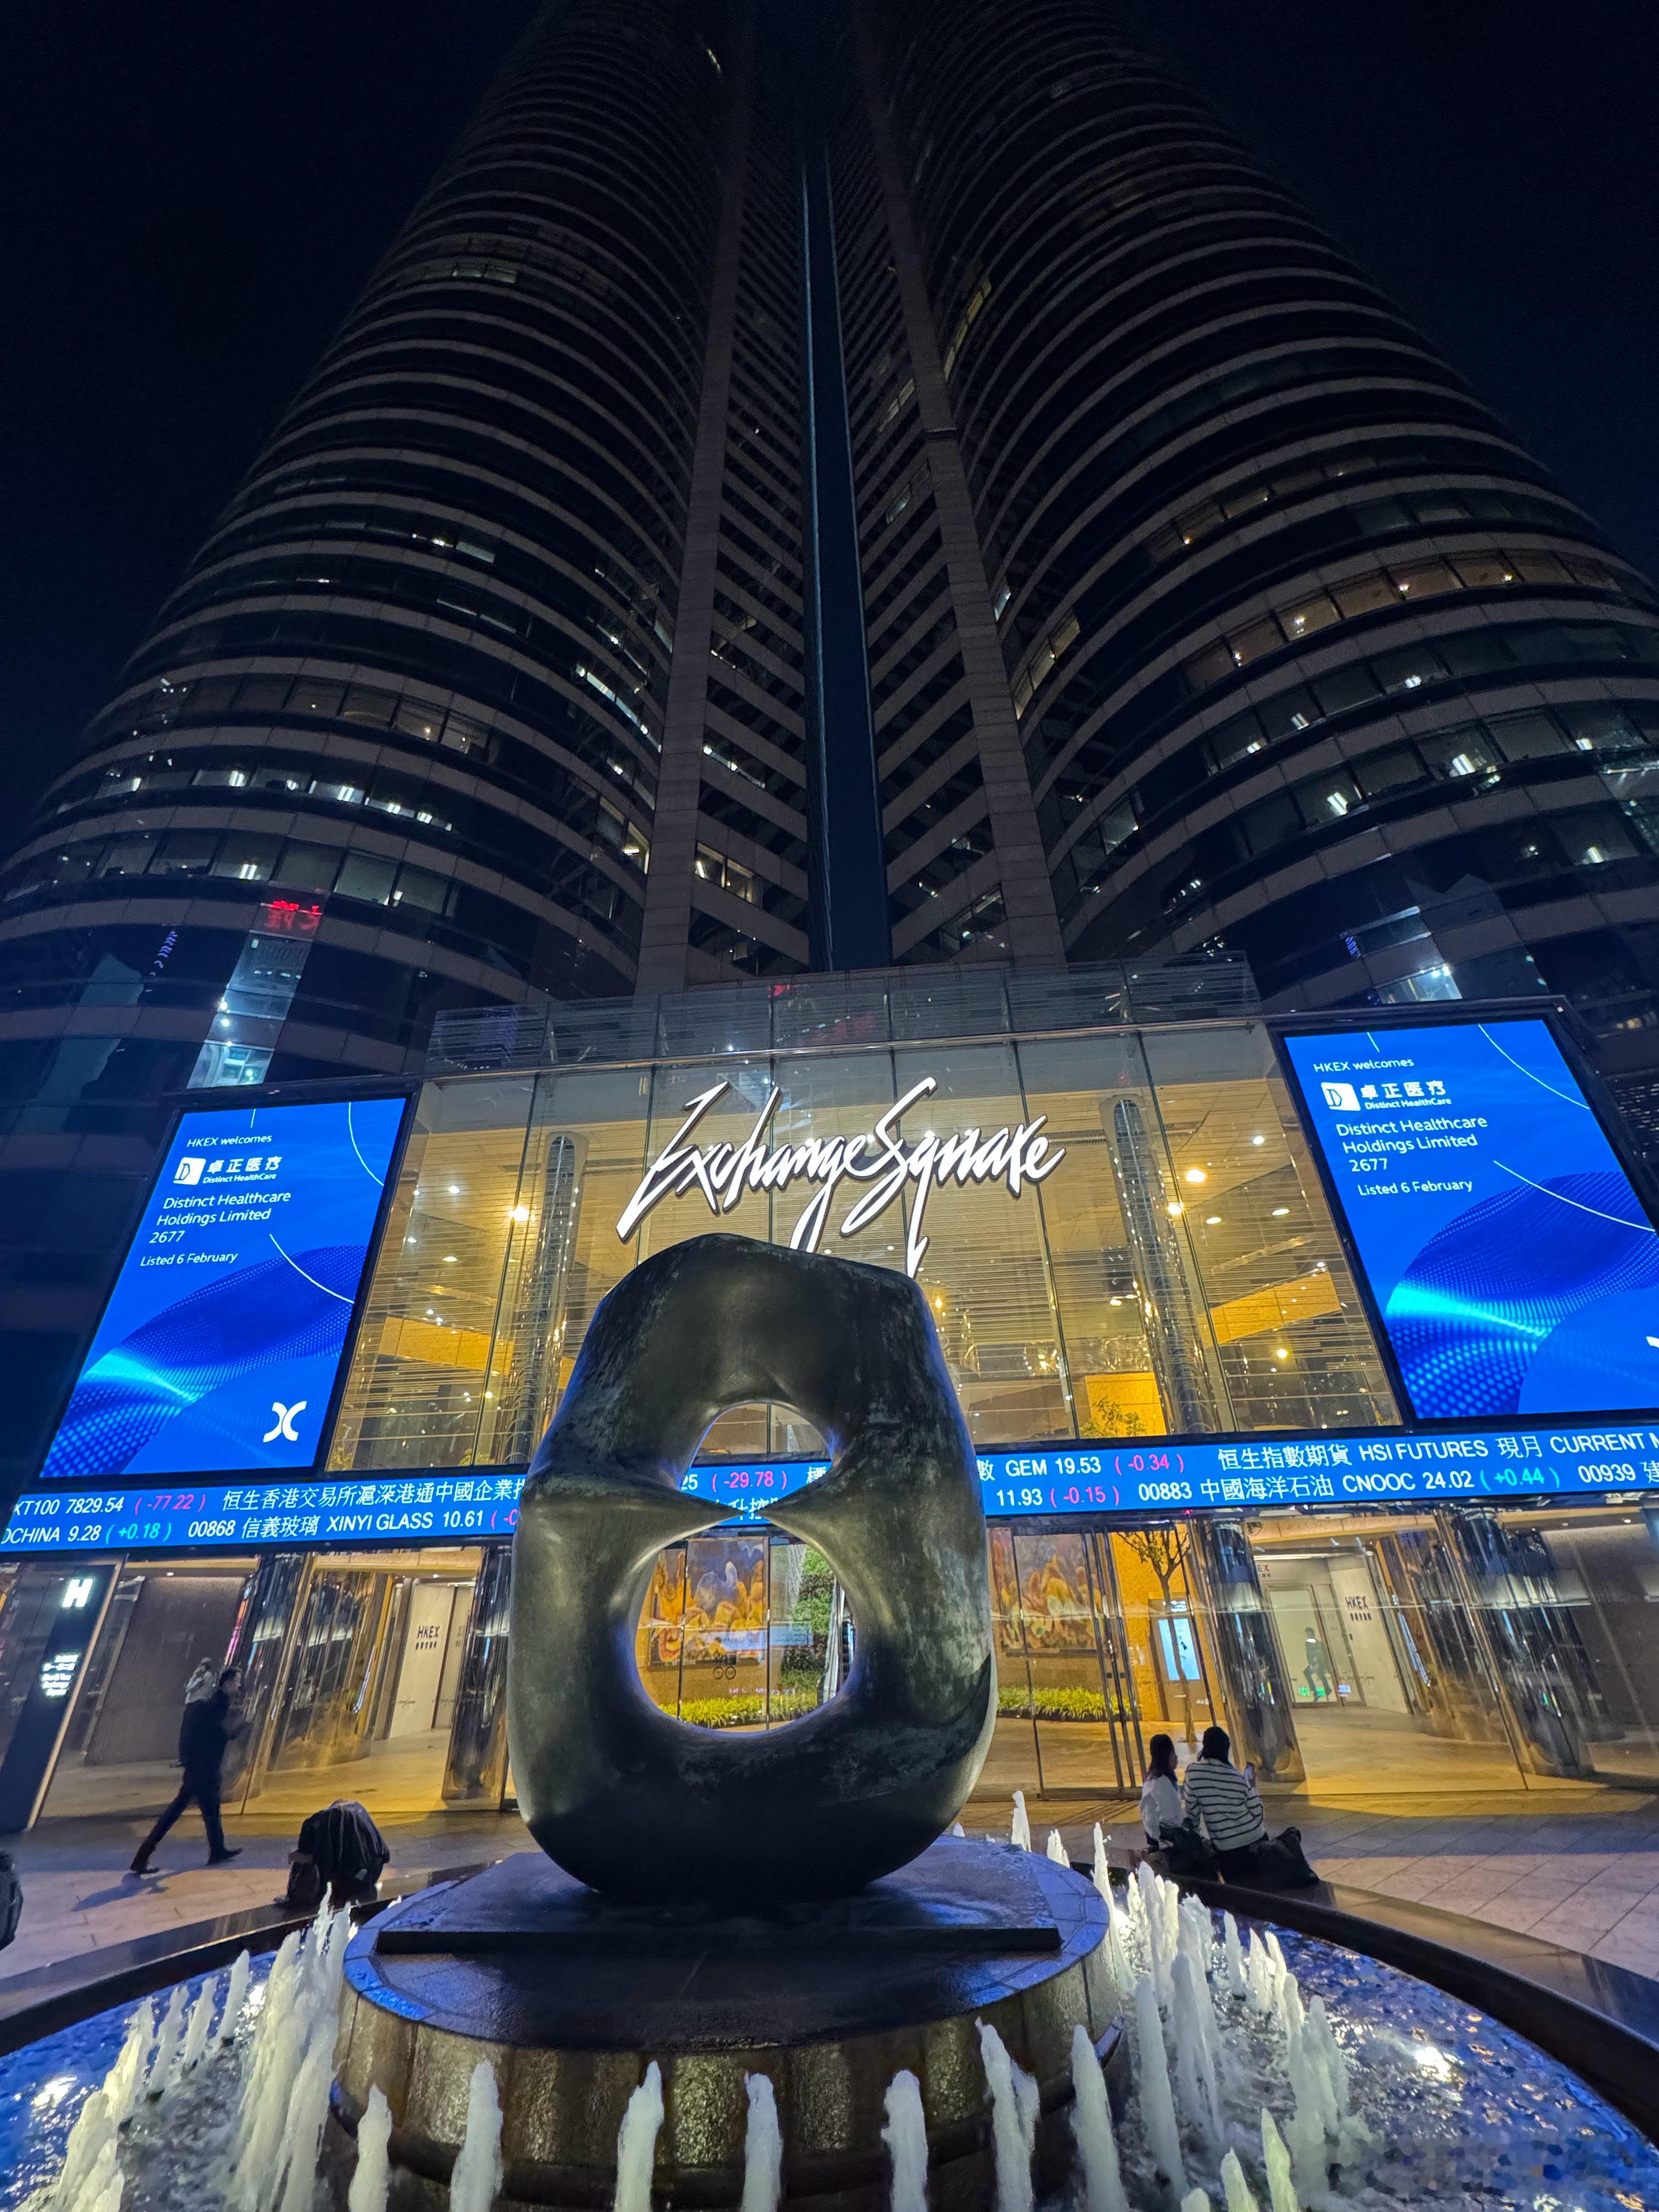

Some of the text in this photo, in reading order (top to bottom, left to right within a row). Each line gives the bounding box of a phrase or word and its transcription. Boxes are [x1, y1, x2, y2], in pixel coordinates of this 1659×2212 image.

[1314, 1059, 1414, 1072] HKEX welcomes
[1361, 1080, 1446, 1099] 卓正医疗
[1365, 1098, 1451, 1109] Distinct HealthCare
[1336, 1118, 1487, 1136] Distinct Healthcare
[187, 1136, 272, 1147] HKEX welcomes
[1343, 1134, 1477, 1153] Holdings Limited
[207, 1156, 282, 1173] 卓正医疗
[1349, 1158, 1387, 1171] 2677
[616, 1076, 1066, 1279] Exchange Square
[1358, 1181, 1471, 1195] Listed 6 February
[163, 1193, 291, 1209] Distinct Healthcare
[157, 1208, 271, 1226] Holdings Limited
[149, 1231, 185, 1243] 2677
[140, 1252, 238, 1266] Listed 6 February
[66, 1497, 124, 1514] 7829.54
[1005, 1459, 1047, 1477] GEM
[1055, 1457, 1101, 1474] 19.53
[1218, 1444, 1352, 1470] 恒生指數期貨
[1359, 1444, 1392, 1460] HSI
[1396, 1440, 1488, 1459] FUTURES
[1496, 1436, 1542, 1458] 現月
[1550, 1433, 1644, 1453] CURRENT
[68, 1525, 101, 1541] 9.28
[189, 1520, 235, 1537] 00868
[242, 1515, 320, 1538] 信義玻璃
[326, 1515, 372, 1532] XINYI
[376, 1512, 433, 1530] GLASS
[444, 1510, 483, 1527] 10.61
[996, 1489, 1042, 1506] 11.93
[1139, 1482, 1192, 1500] 00883
[1200, 1475, 1334, 1502] 中國海洋石油
[1343, 1473, 1415, 1492] CNOOC
[1423, 1471, 1474, 1489] 24.02
[1578, 1464, 1635, 1482] 00939
[1345, 1595, 1369, 1610] HKEX
[417, 1626, 440, 1639] HKEX
